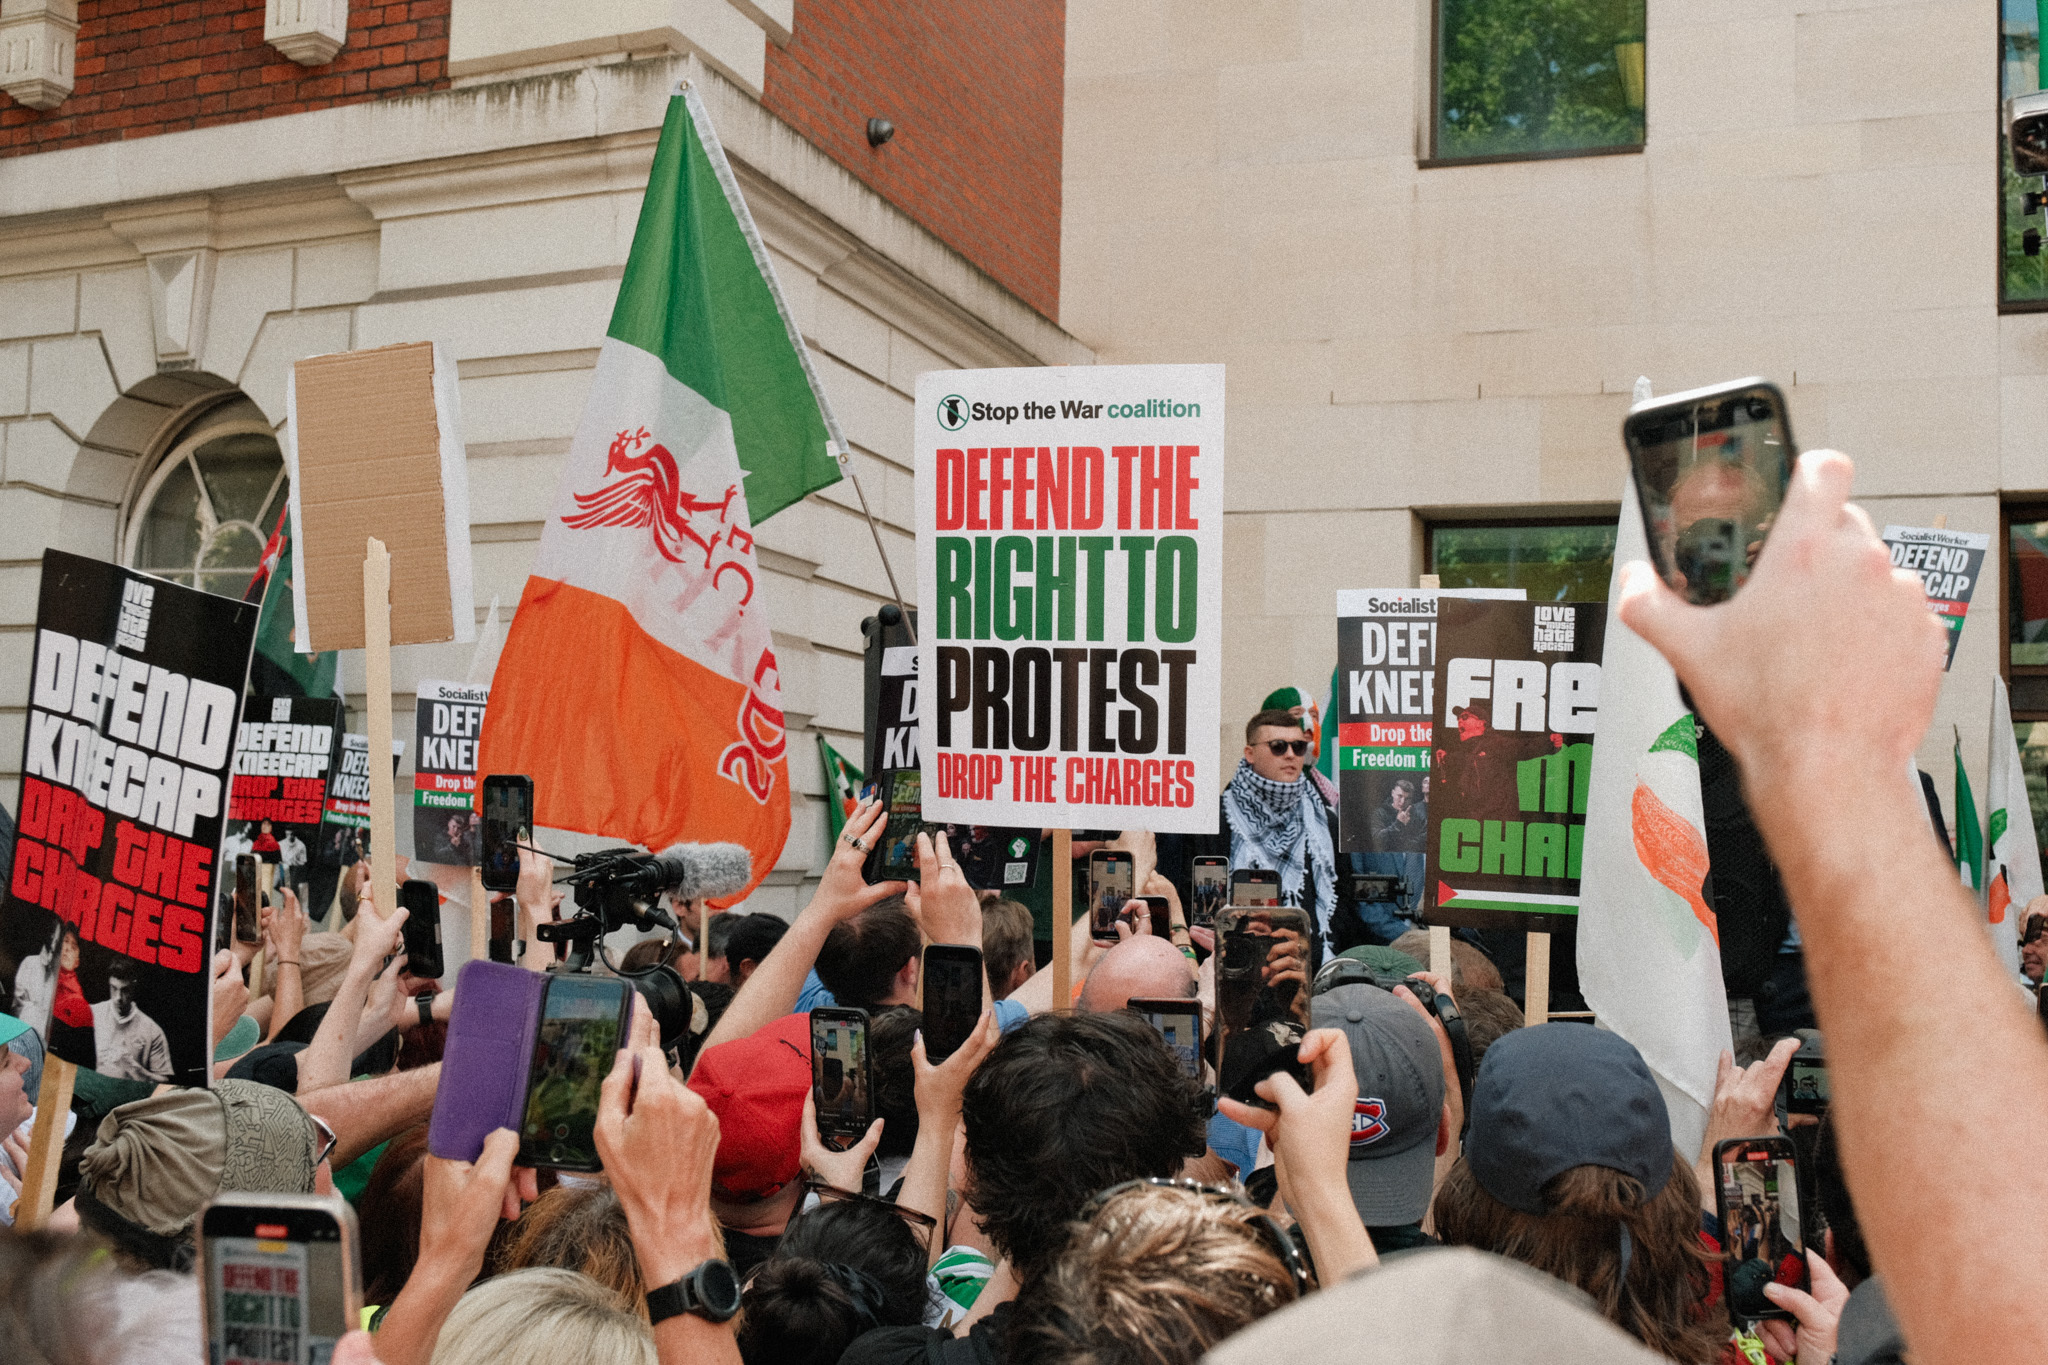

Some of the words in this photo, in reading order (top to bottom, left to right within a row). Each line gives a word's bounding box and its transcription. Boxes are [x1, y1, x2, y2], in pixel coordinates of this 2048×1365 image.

[971, 402, 1019, 425] Stop
[1023, 401, 1056, 420] the
[1060, 400, 1104, 420] War
[1107, 399, 1201, 418] coalition
[936, 446, 1104, 531] DEFEND
[1111, 445, 1199, 531] THE
[1890, 542, 1969, 573] DEFEND
[936, 535, 1114, 641] RIGHT
[1120, 535, 1198, 643] TO
[1917, 570, 1970, 599] CAP
[1368, 597, 1436, 614] Socialist
[33, 628, 236, 770] DEFEND
[438, 687, 484, 701] Socialist
[936, 646, 1196, 754] PROTEST
[237, 722, 333, 754] DEFEND
[1370, 724, 1406, 745] Drop
[1410, 724, 1432, 742] the
[234, 751, 329, 778] KNEECAP
[1353, 749, 1416, 768] Freedom
[435, 775, 460, 791] Drop
[937, 752, 1002, 800] DROP
[1010, 755, 1056, 803] THE
[1065, 756, 1195, 808] CHARGES
[422, 791, 466, 808] Freedom
[19, 776, 105, 866] DRP
[112, 819, 213, 908] THE
